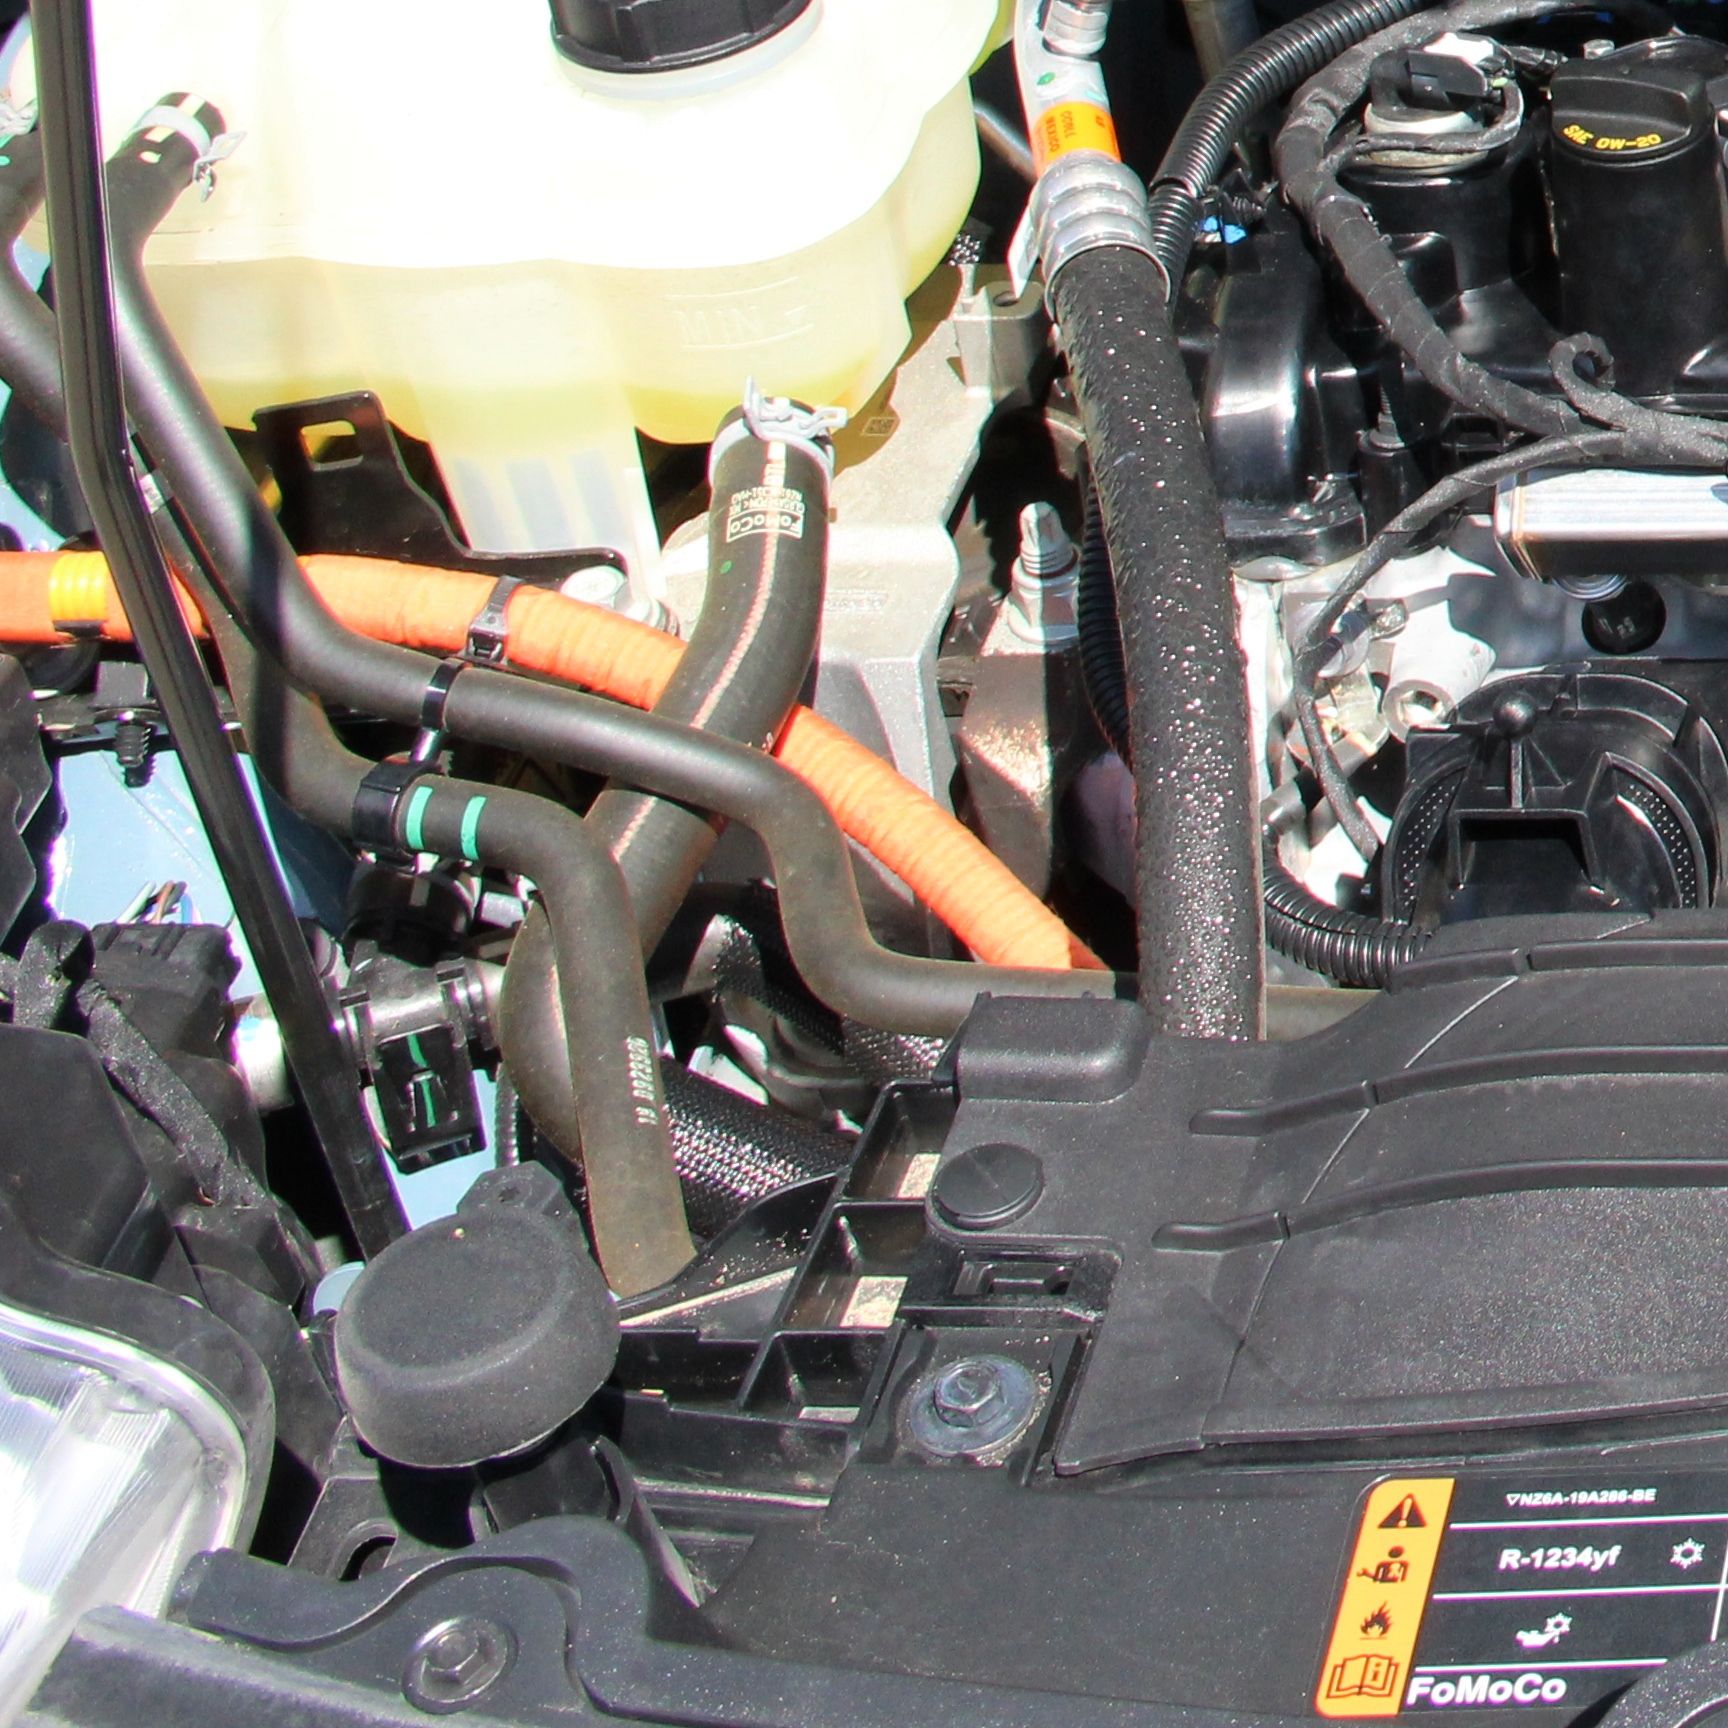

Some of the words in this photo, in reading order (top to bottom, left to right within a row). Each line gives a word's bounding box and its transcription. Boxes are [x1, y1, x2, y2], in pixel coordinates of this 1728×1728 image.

[1563, 124, 1594, 145] SAE
[1595, 133, 1662, 150] 0W-20
[731, 515, 801, 534] FoMoCo
[1499, 1544, 1622, 1571] R-1234yf
[1406, 1673, 1567, 1706] FoMoCo
